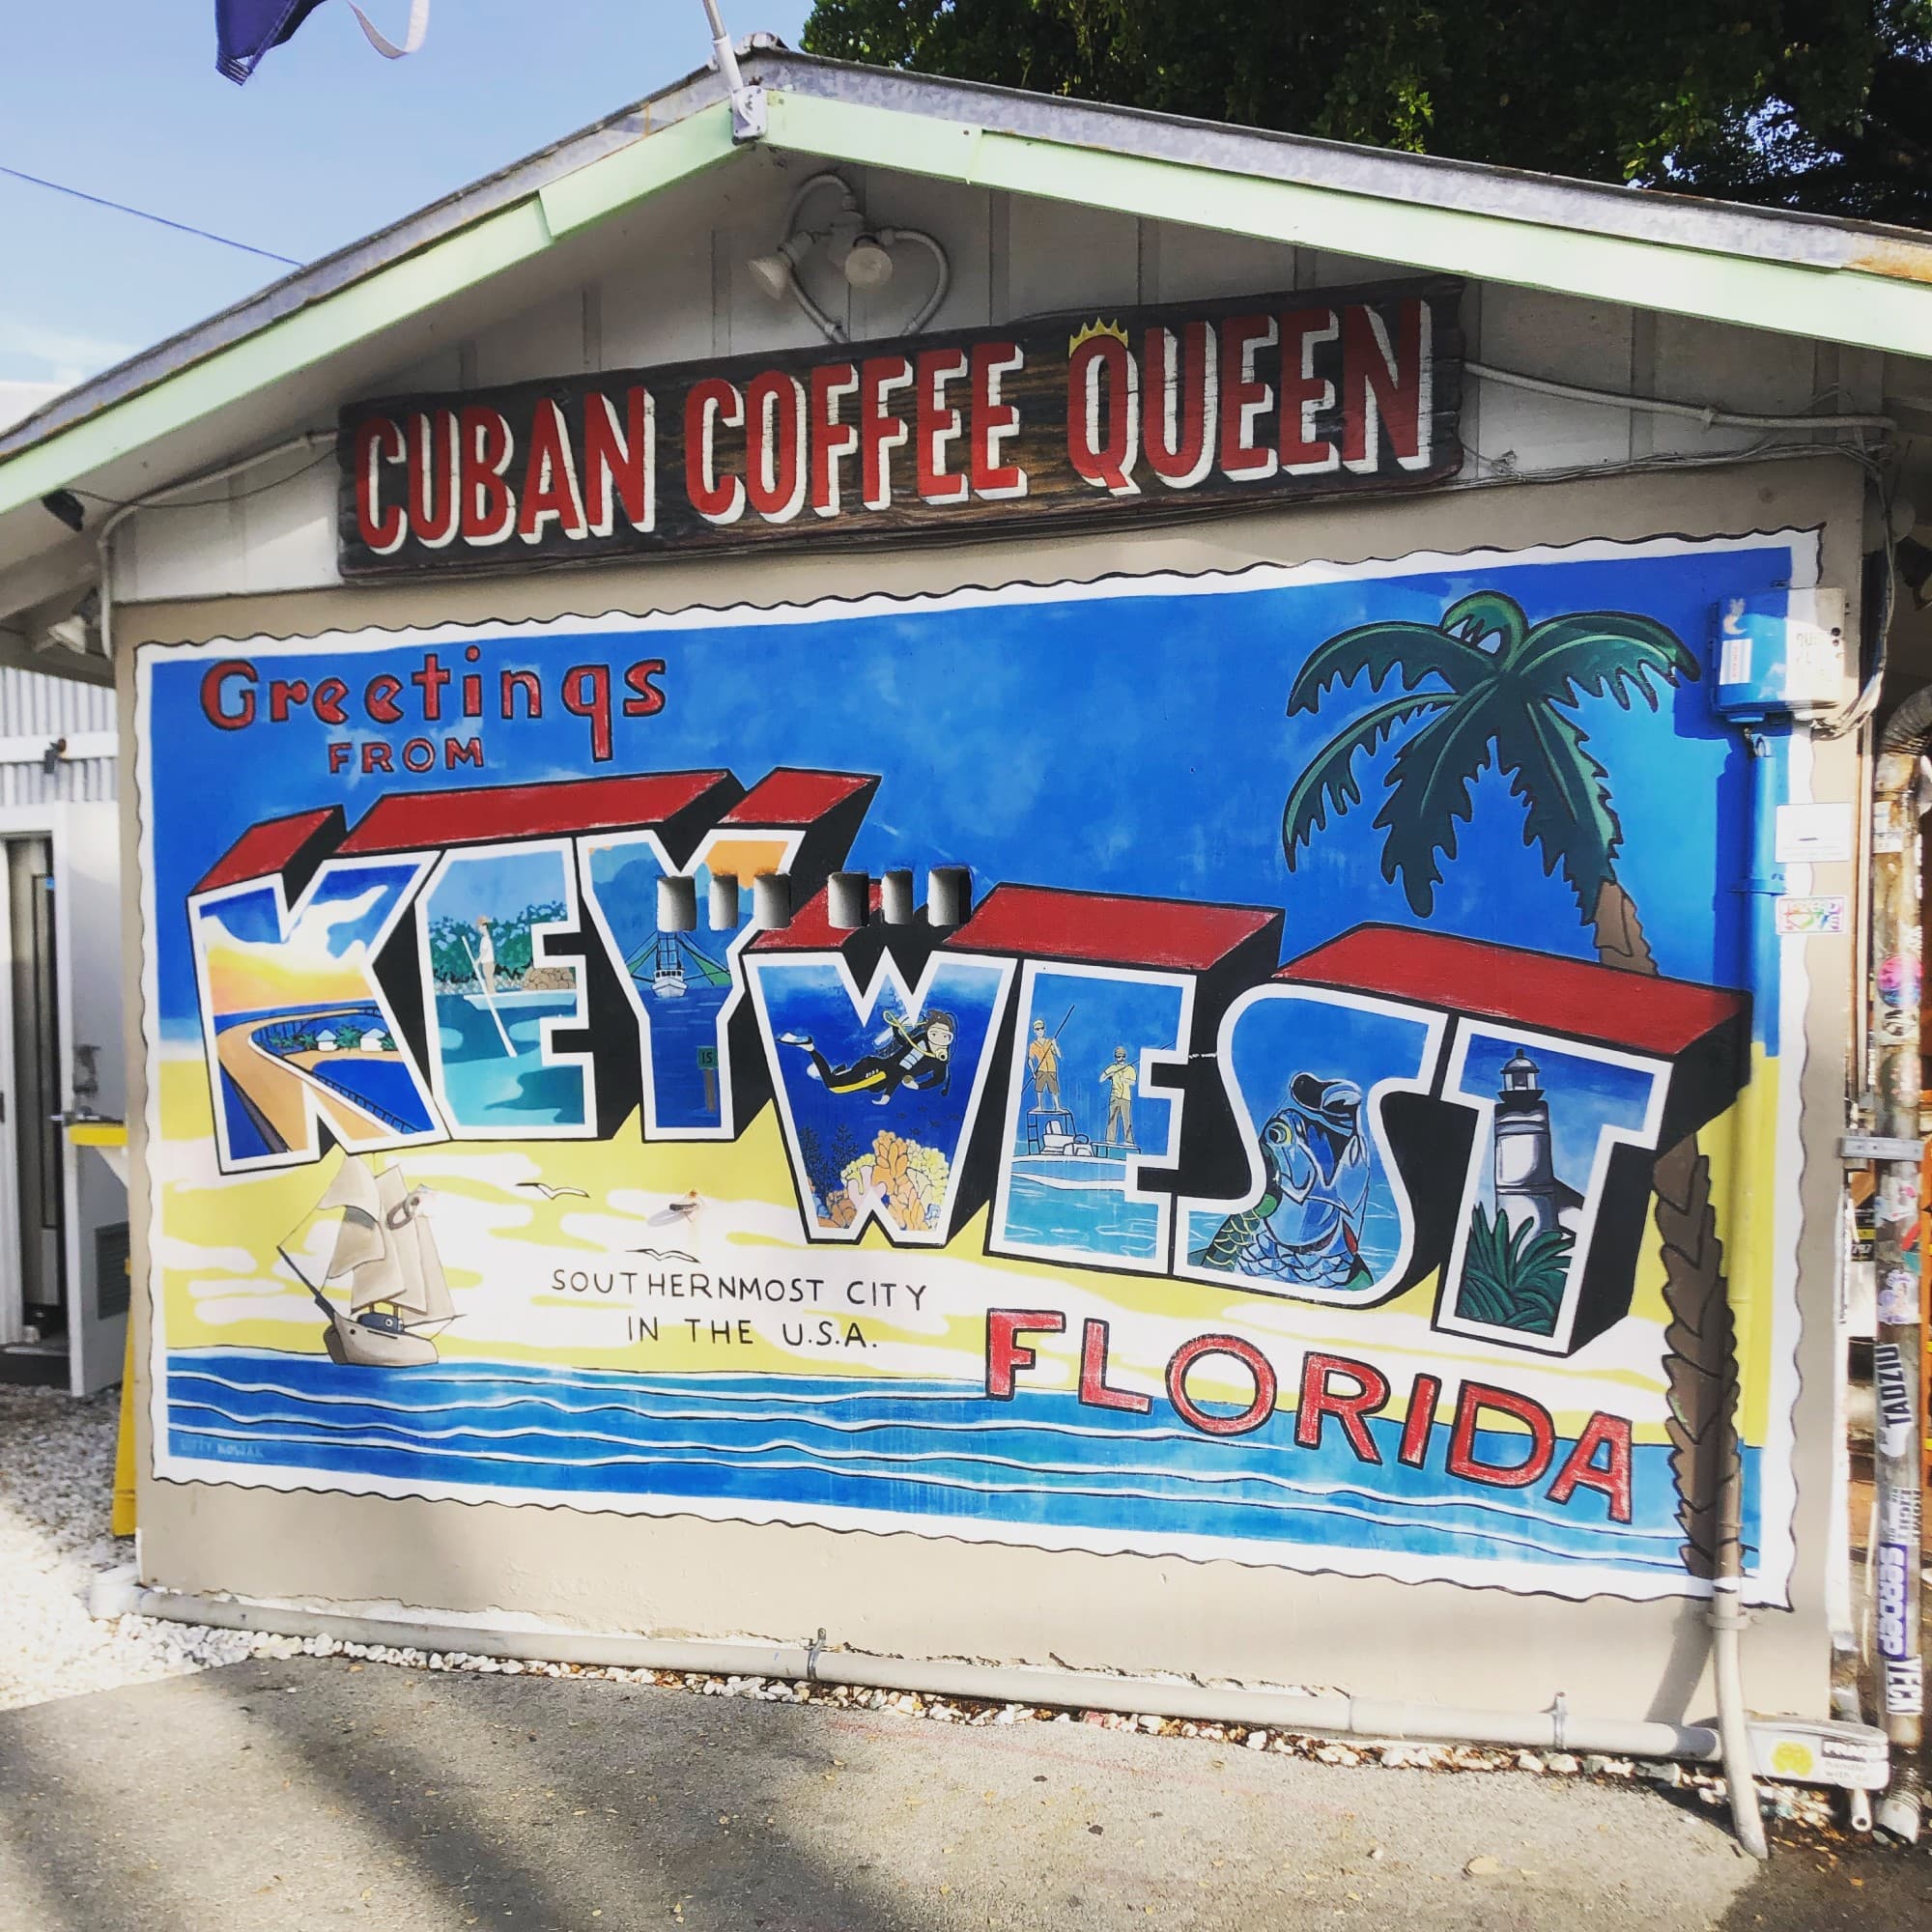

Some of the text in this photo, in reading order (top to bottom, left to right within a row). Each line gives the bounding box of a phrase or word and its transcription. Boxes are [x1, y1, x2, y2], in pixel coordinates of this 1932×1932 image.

[355, 299, 1433, 554] CUBAN COFFEE QUEEN
[328, 736, 485, 774] FROM
[186, 769, 1753, 1358] KEY WEST
[552, 1268, 927, 1312] SOUTHERNMOST CITY
[627, 1315, 879, 1349] IN THE U.S.A.
[985, 1309, 1633, 1524] FLORIDA
